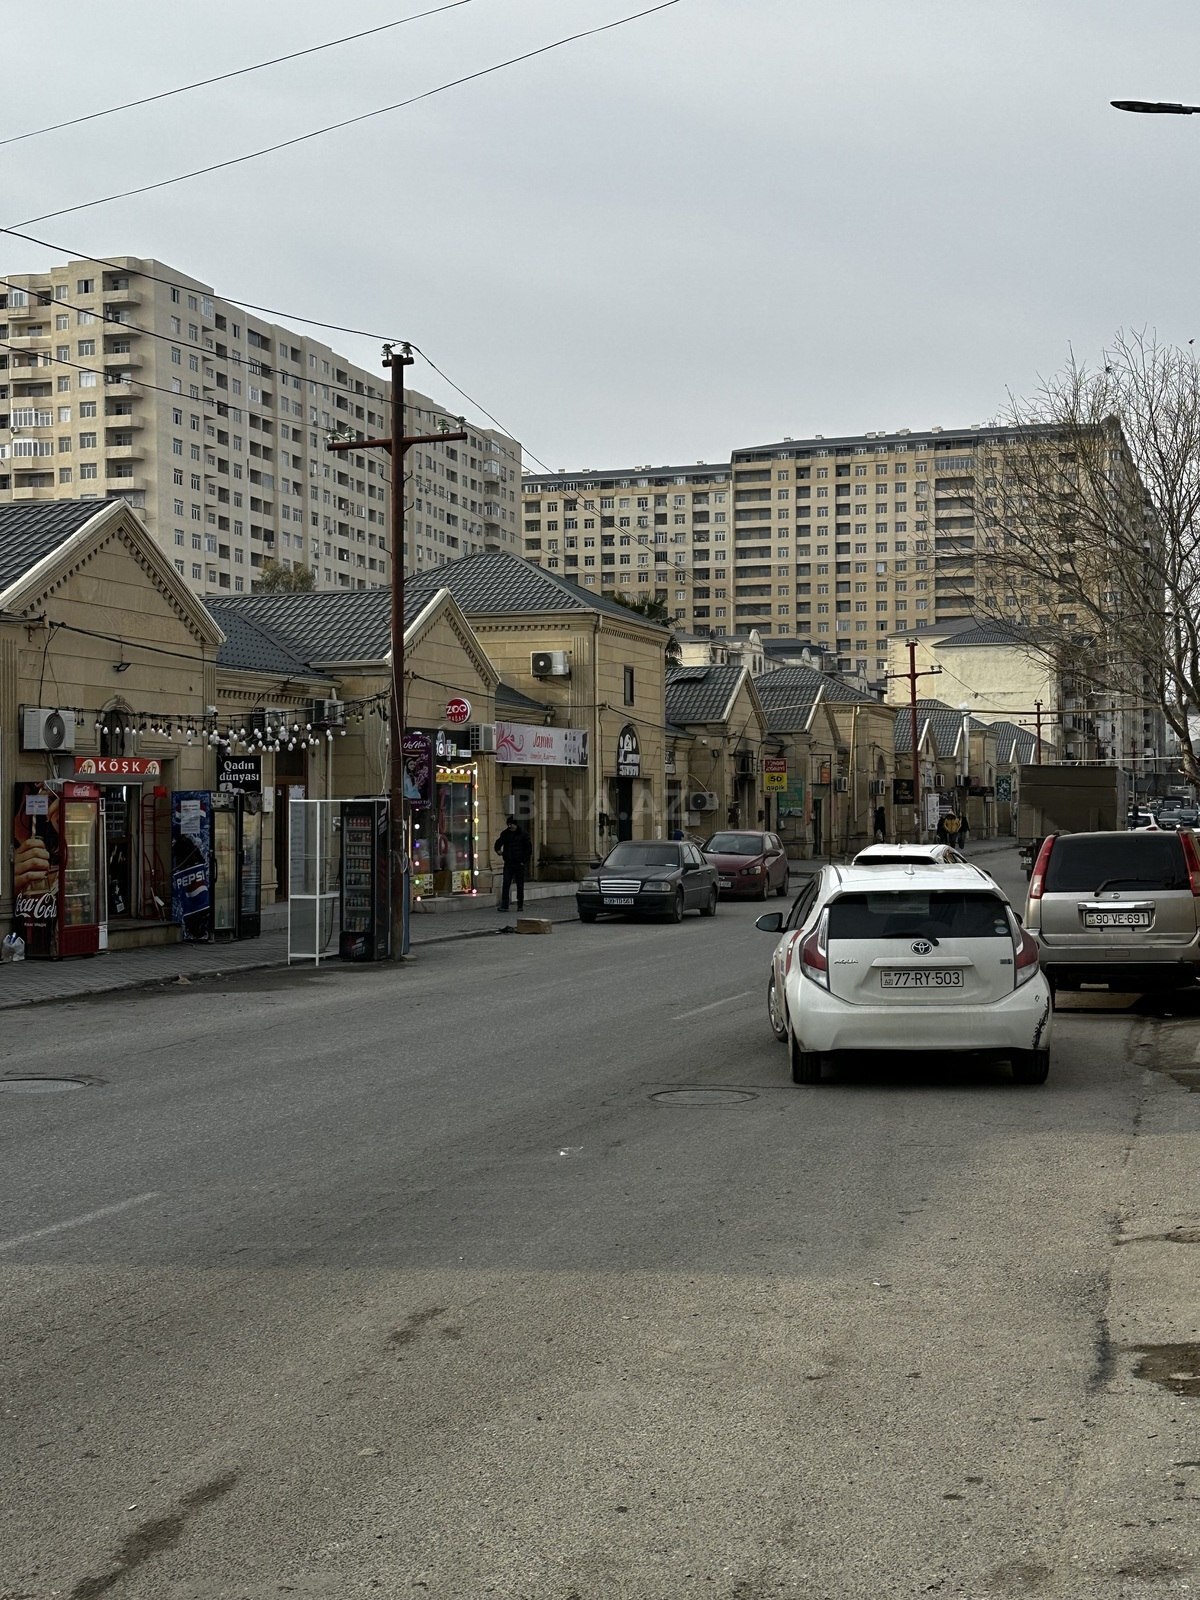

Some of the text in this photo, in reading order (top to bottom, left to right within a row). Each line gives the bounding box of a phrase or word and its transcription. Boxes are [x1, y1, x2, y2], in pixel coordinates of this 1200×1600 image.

[446, 704, 467, 714] ZOO
[98, 758, 140, 773] KÖŞK
[224, 761, 255, 772] Qadın
[219, 771, 260, 783] dünyası
[176, 869, 206, 889] PEPSI
[1096, 913, 1146, 924] 90-VE-691
[894, 971, 961, 986] 77-RY-503
